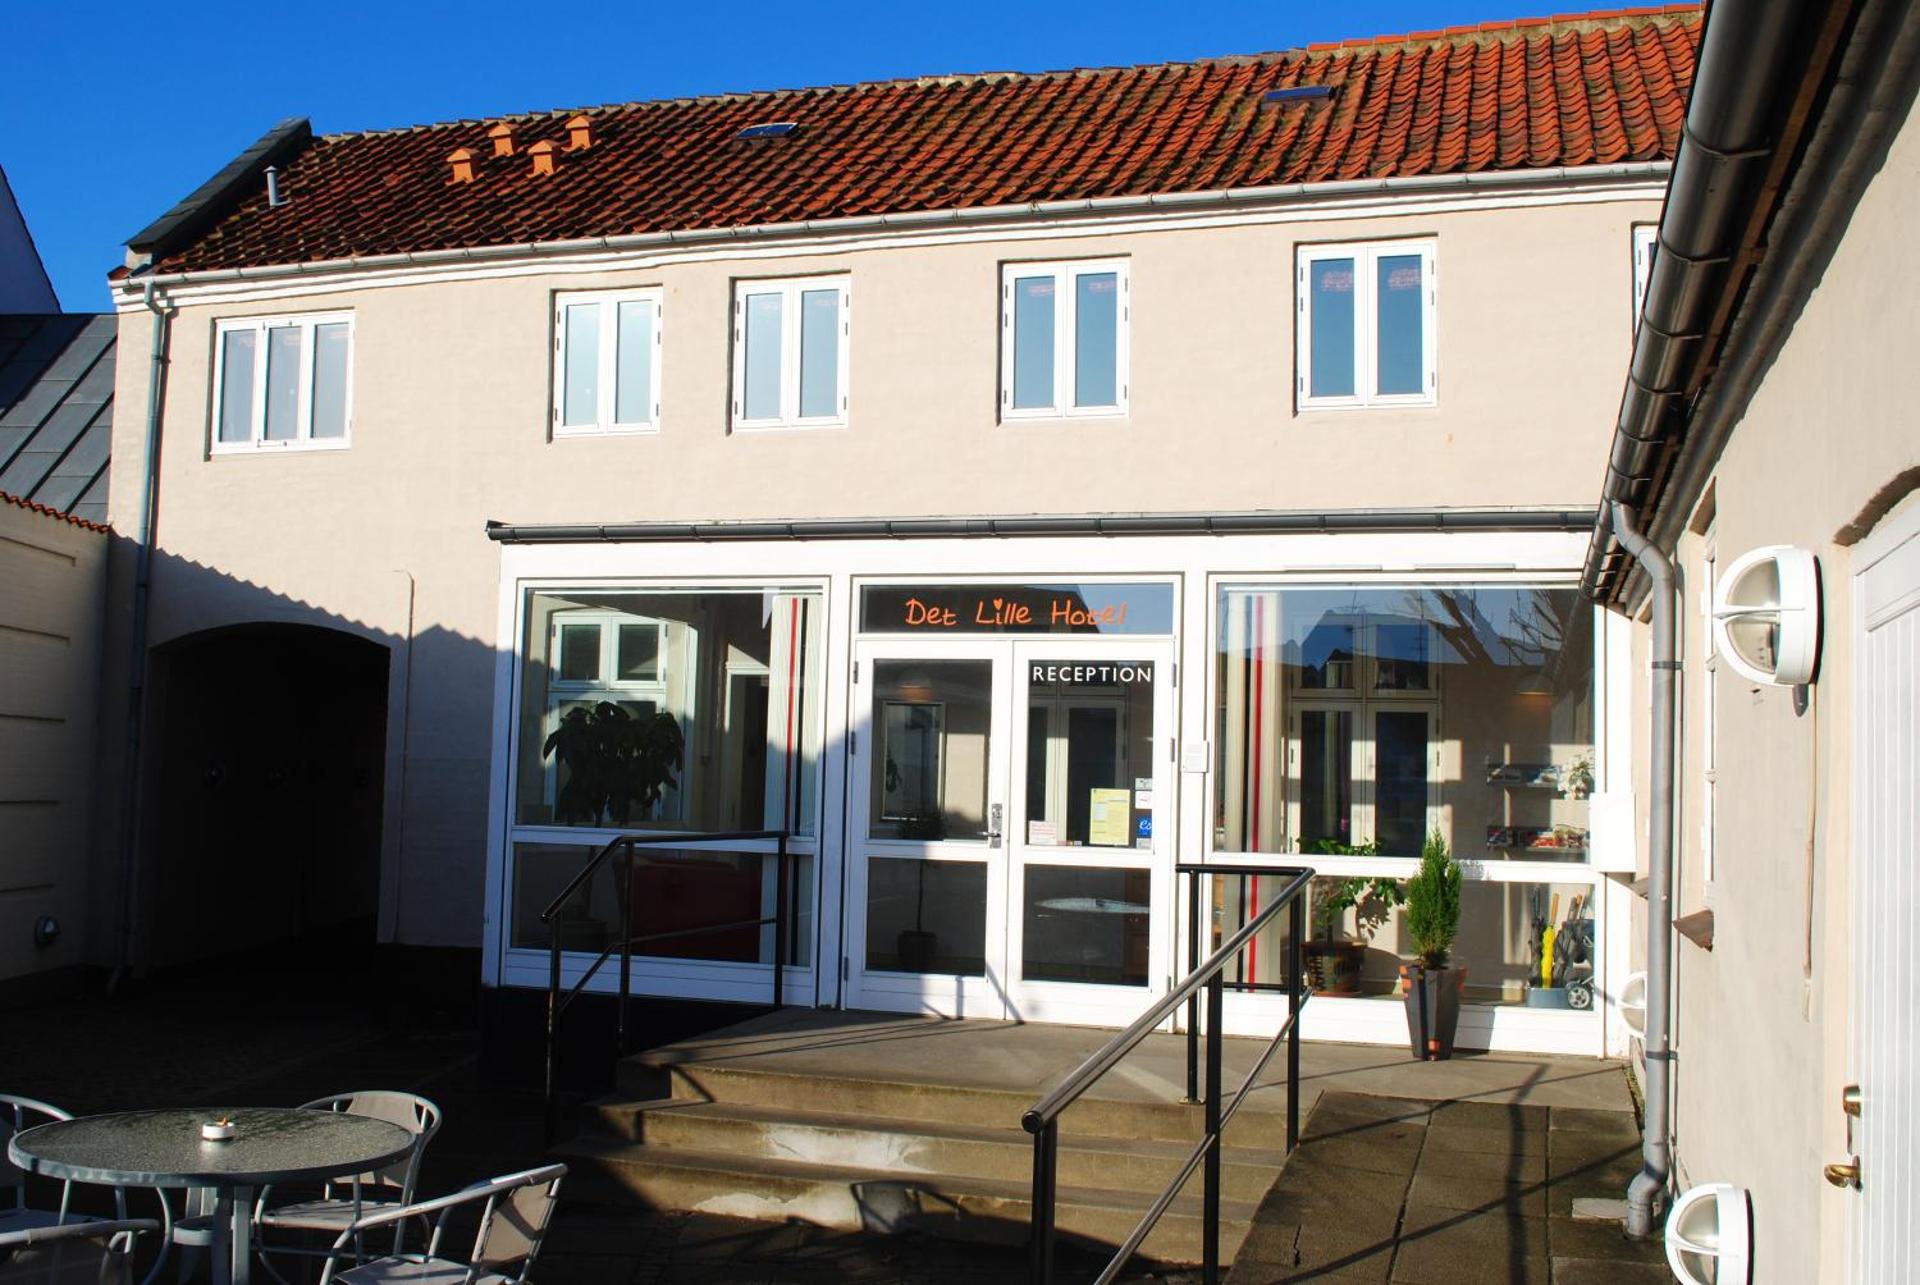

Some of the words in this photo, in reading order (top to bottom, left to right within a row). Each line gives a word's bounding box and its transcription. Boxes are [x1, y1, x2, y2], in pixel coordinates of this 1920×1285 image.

[905, 598, 957, 625] Det
[975, 598, 1032, 625] Lille
[1051, 600, 1127, 626] Hotel
[1032, 666, 1151, 682] RECEPTION
